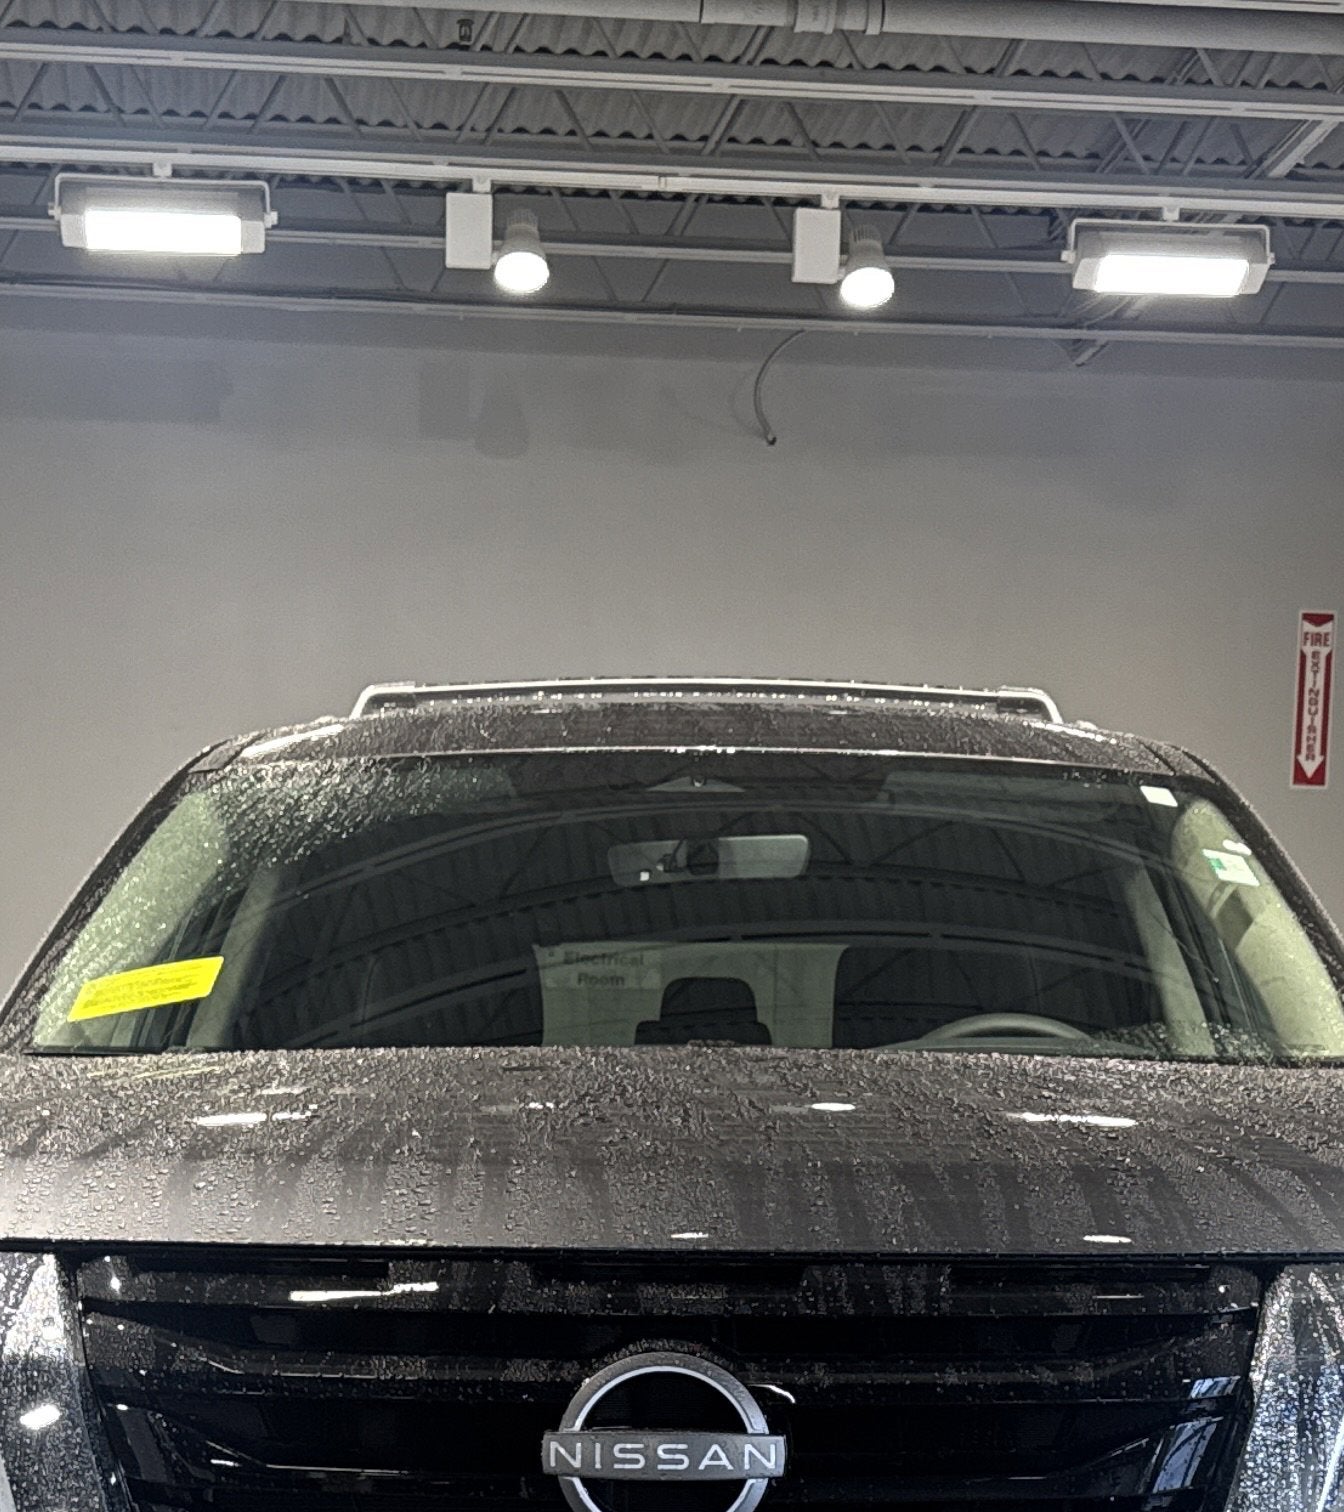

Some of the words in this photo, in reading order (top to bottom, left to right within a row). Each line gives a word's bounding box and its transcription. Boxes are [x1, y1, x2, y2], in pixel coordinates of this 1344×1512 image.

[1302, 631, 1330, 647] FIRE
[578, 972, 625, 986] Room
[549, 1441, 777, 1471] NISSAN
